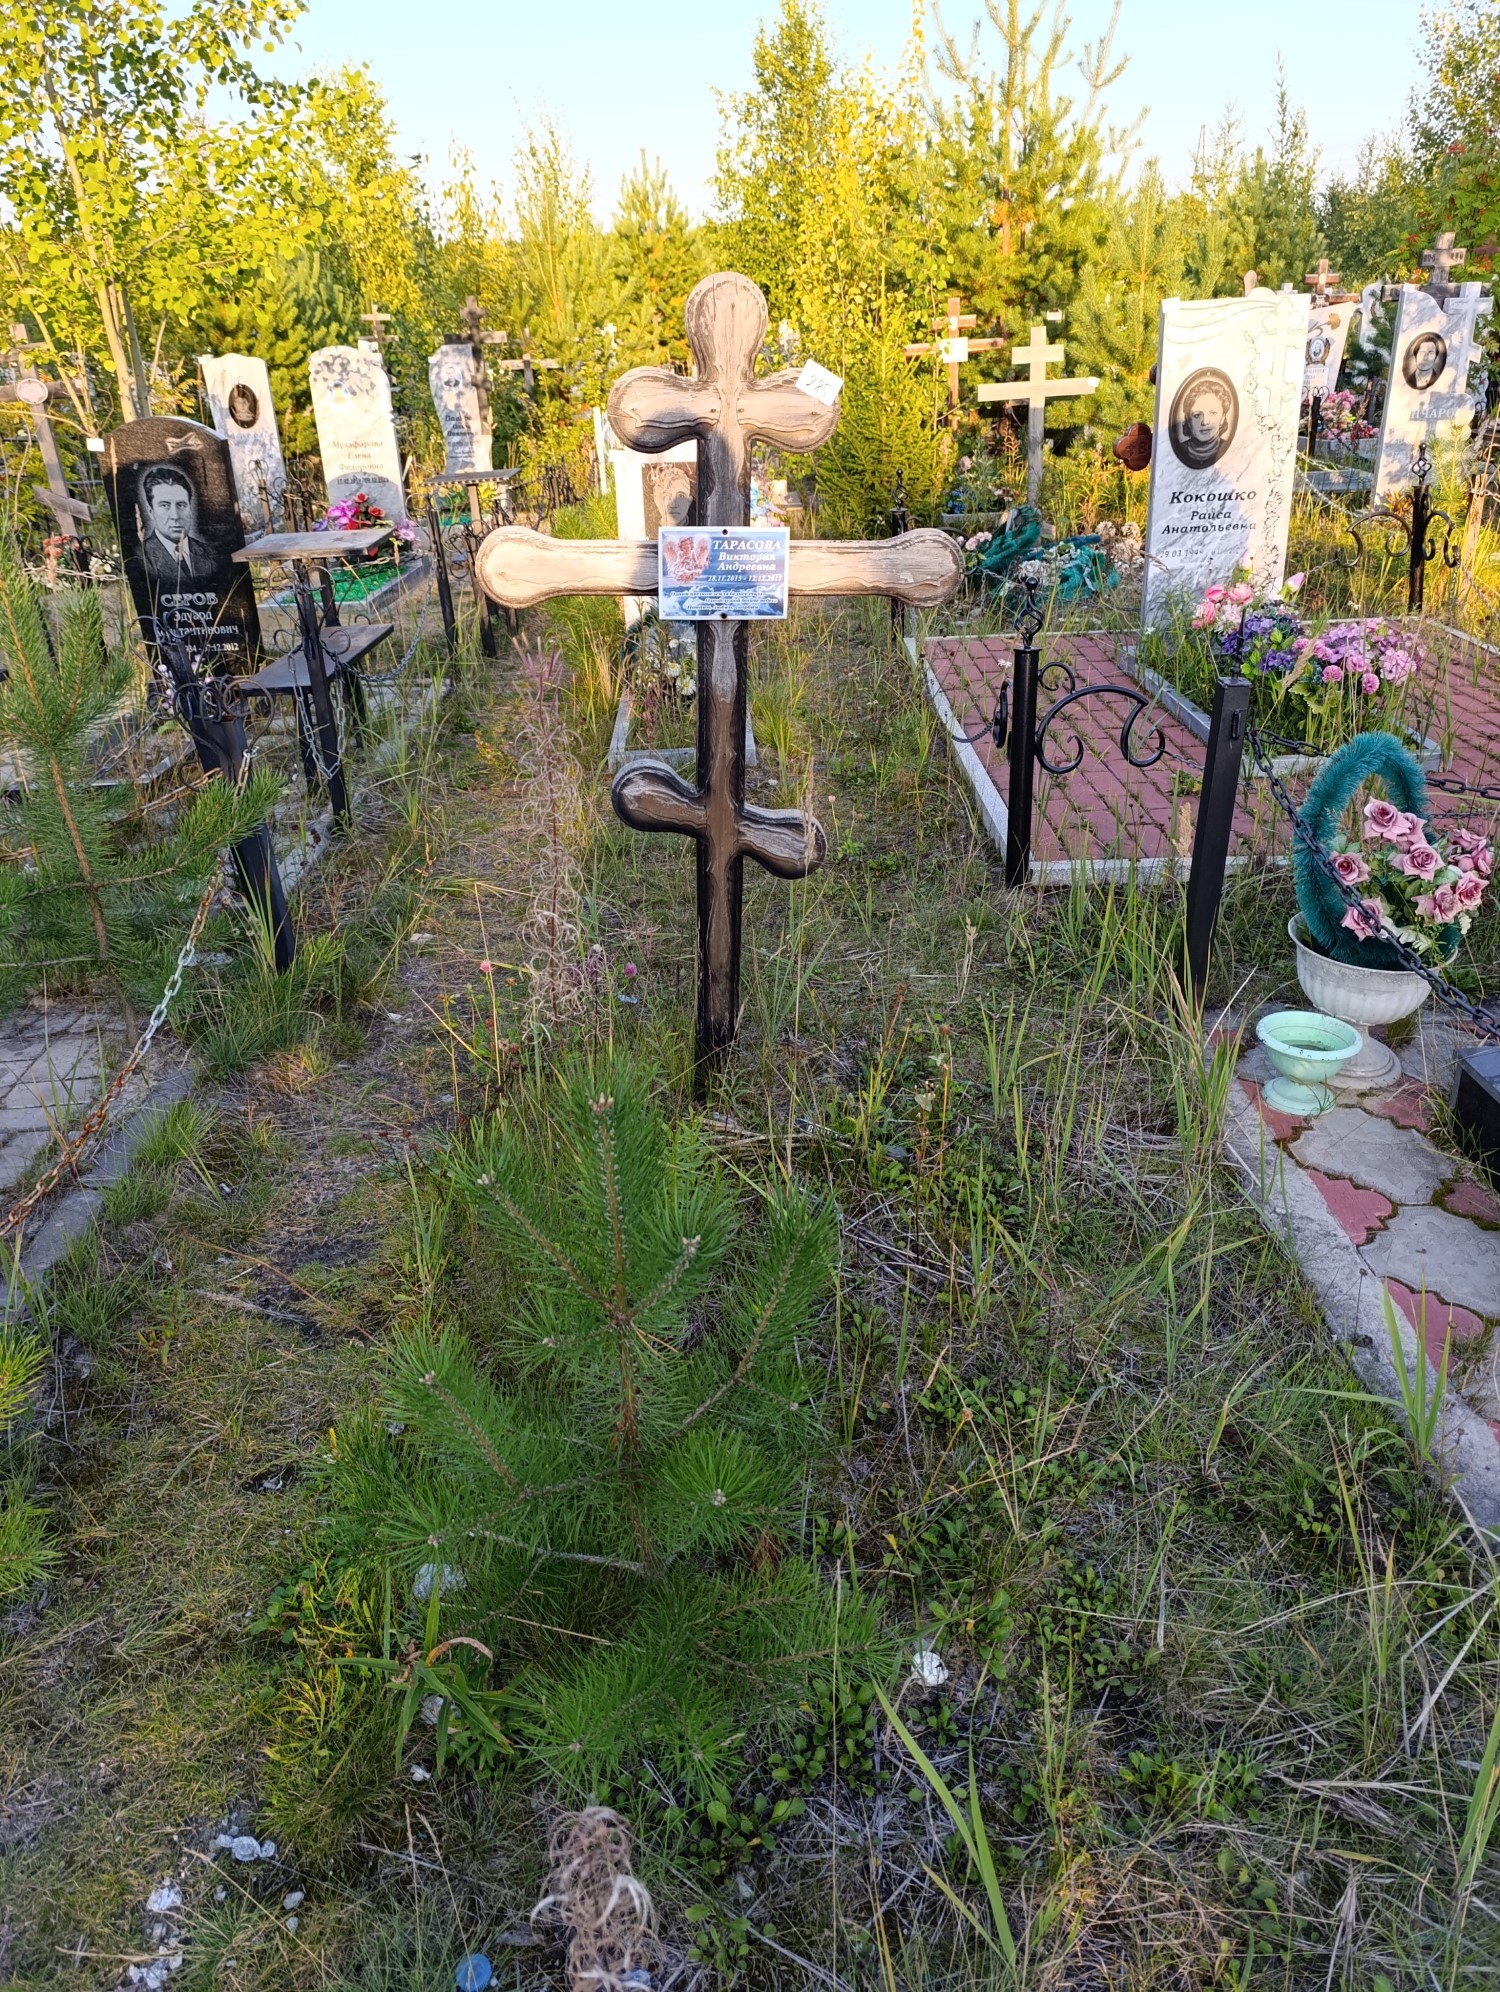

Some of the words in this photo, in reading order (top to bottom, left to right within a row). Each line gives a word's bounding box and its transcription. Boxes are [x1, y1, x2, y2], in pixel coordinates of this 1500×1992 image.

[1168, 489, 1257, 505] Кокошко
[1190, 510, 1232, 521] Раиса
[1160, 522, 1257, 535] Анатольевна
[713, 540, 782, 550] ТАРАСОВА
[718, 551, 776, 563] Виктория
[716, 562, 777, 573] Андреевна
[707, 574, 742, 582] 28.11.2015
[160, 592, 219, 608] СЕРОВ
[174, 610, 213, 623] Эдуард
